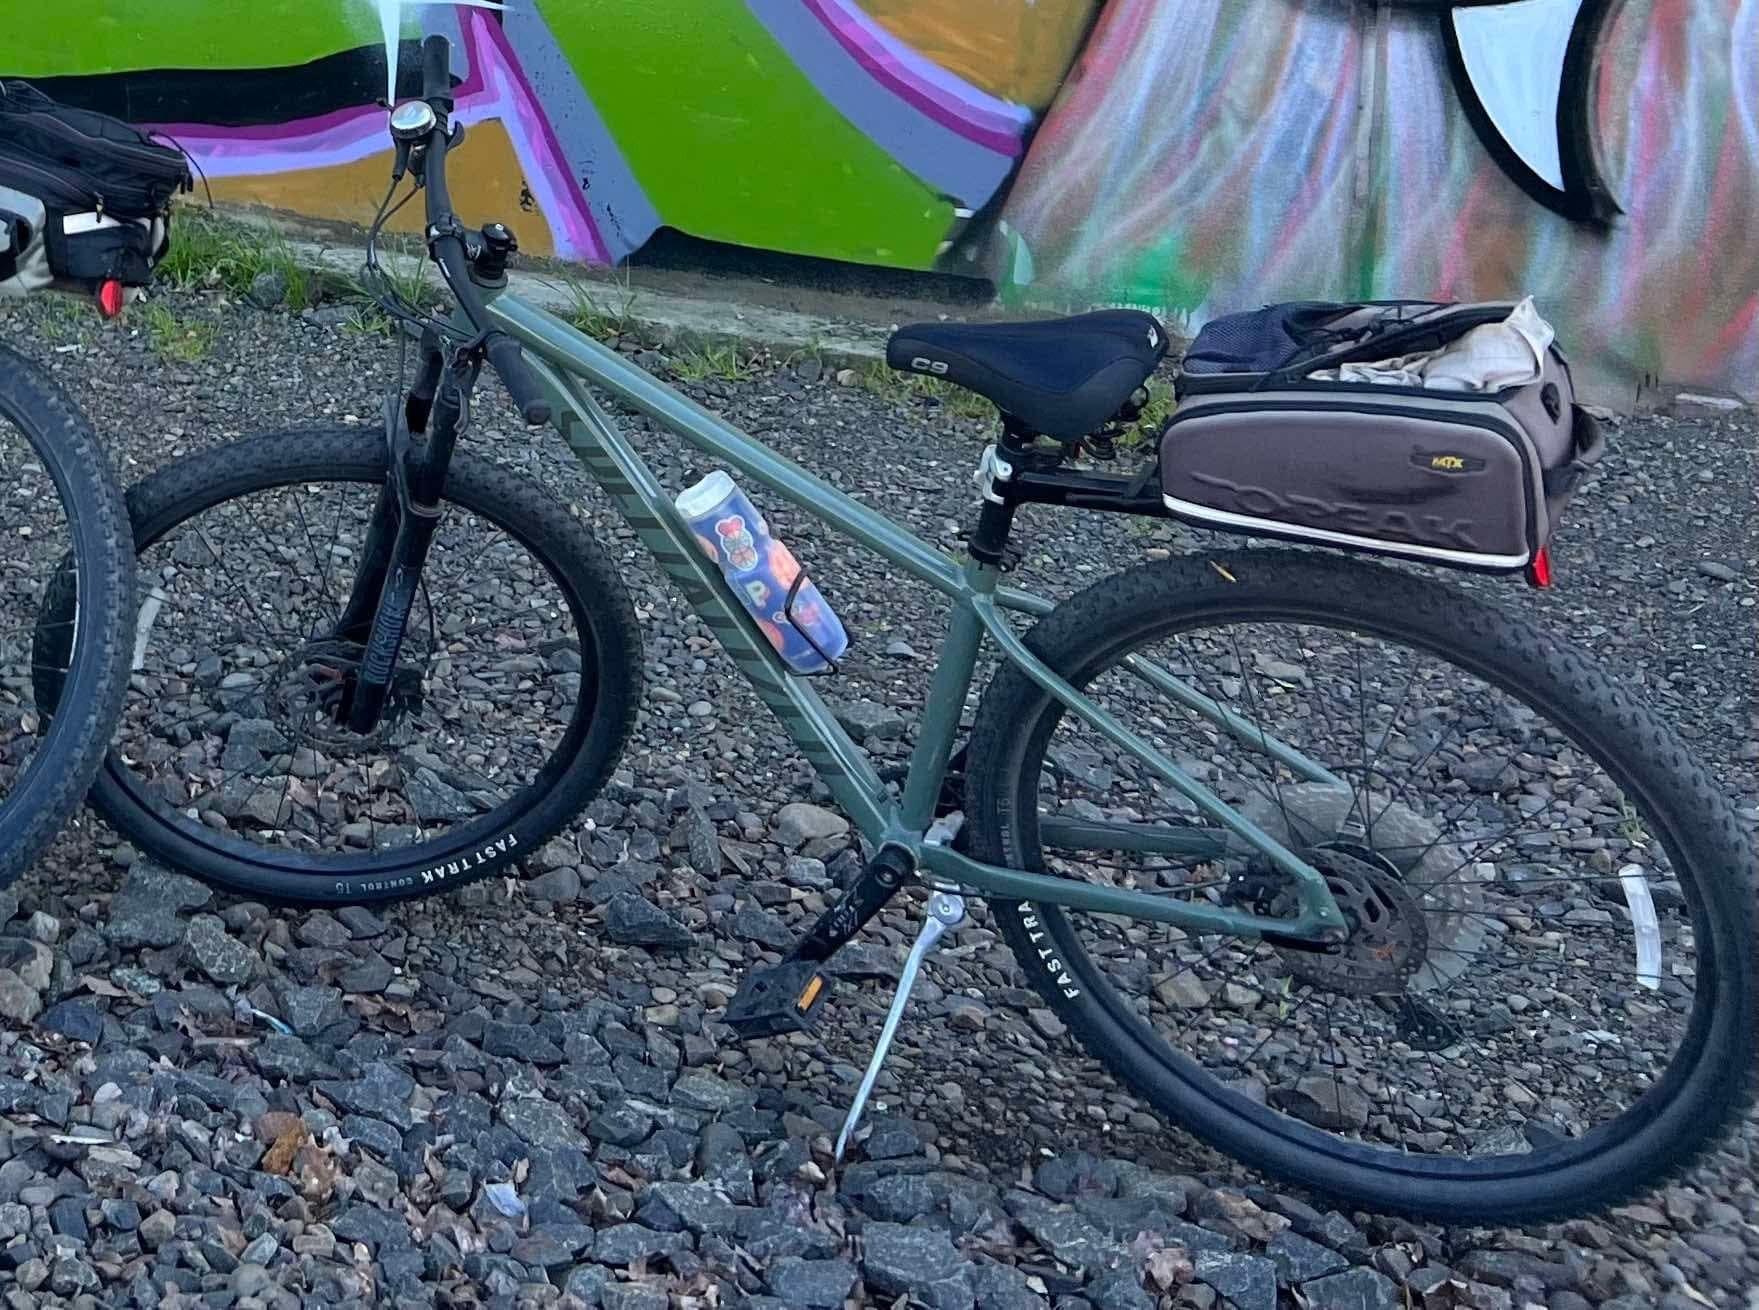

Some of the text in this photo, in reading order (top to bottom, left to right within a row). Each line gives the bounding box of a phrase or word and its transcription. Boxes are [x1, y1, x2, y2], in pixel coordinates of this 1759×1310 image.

[475, 833, 518, 865] FAST
[360, 876, 414, 893] CONTROL
[421, 858, 473, 884] TRAK
[1018, 900, 1044, 943] TRA
[1038, 948, 1080, 999] FAST
